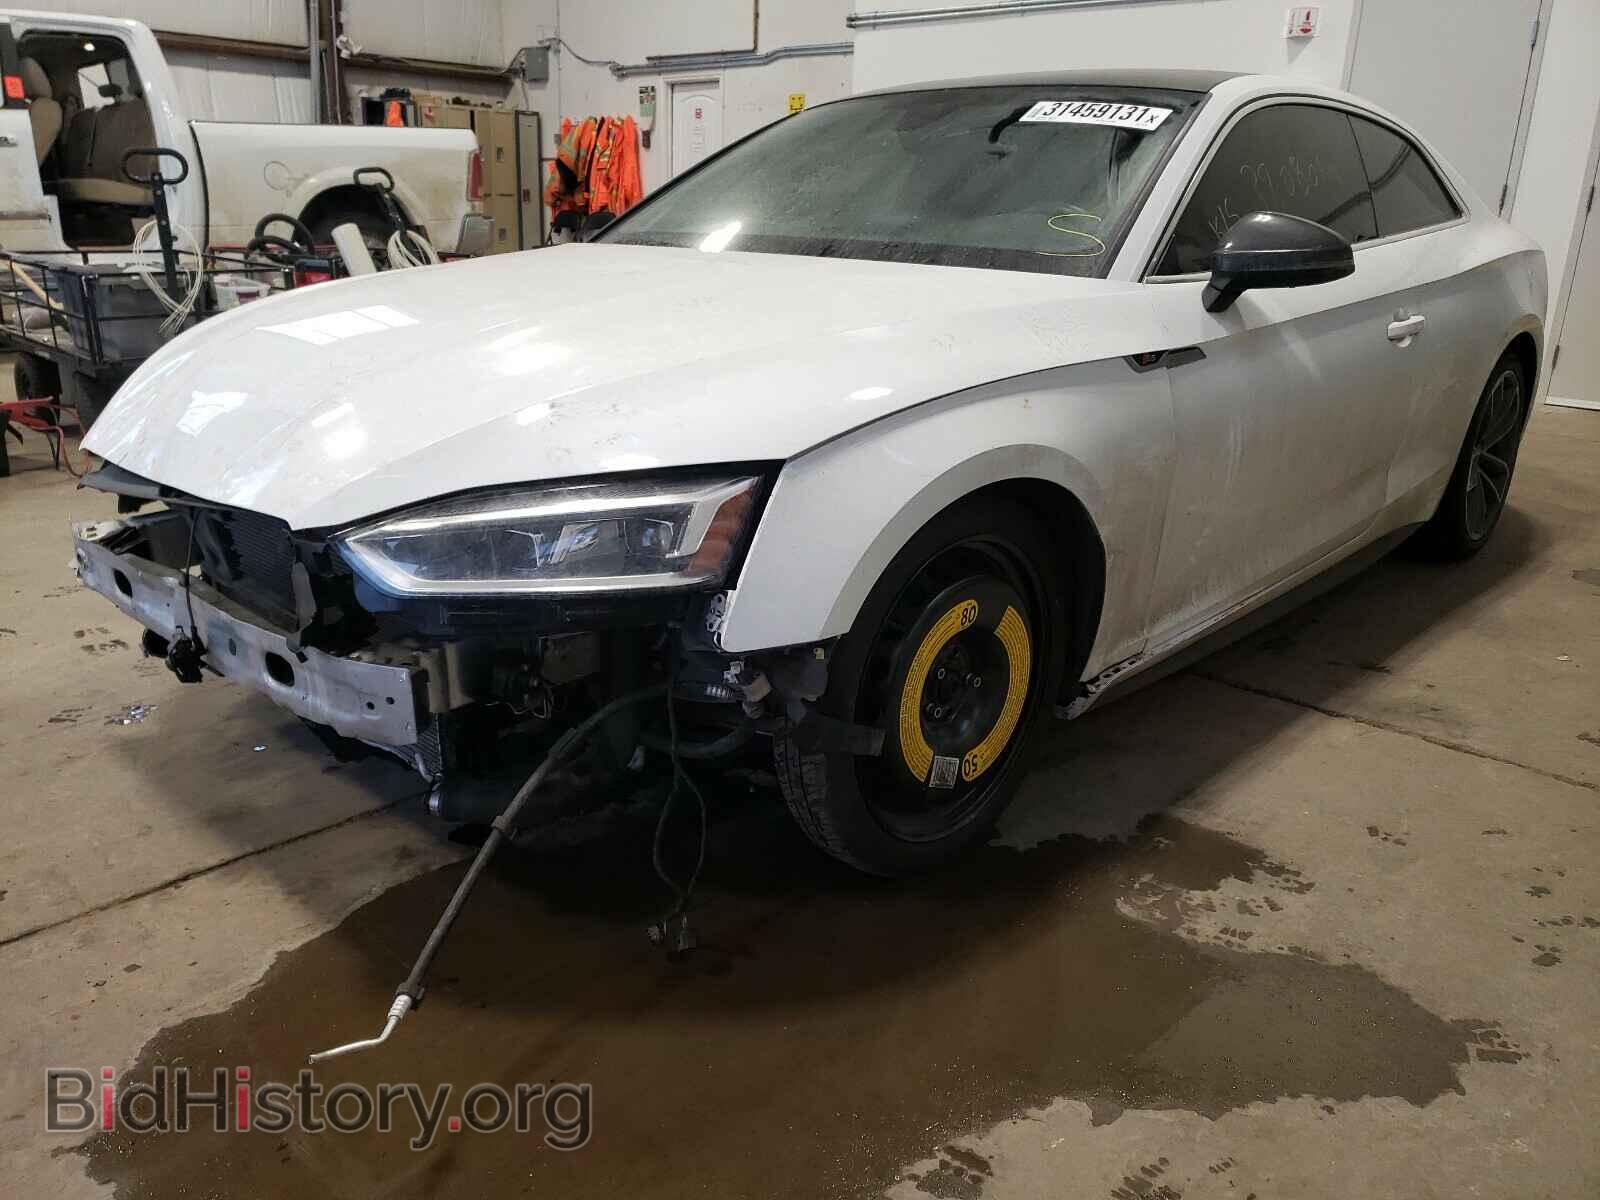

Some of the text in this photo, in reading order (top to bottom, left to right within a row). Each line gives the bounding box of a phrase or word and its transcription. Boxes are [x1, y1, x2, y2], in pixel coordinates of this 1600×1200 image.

[1043, 102, 1151, 121] 31459131
[960, 605, 977, 627] 80
[963, 754, 978, 777] 50
